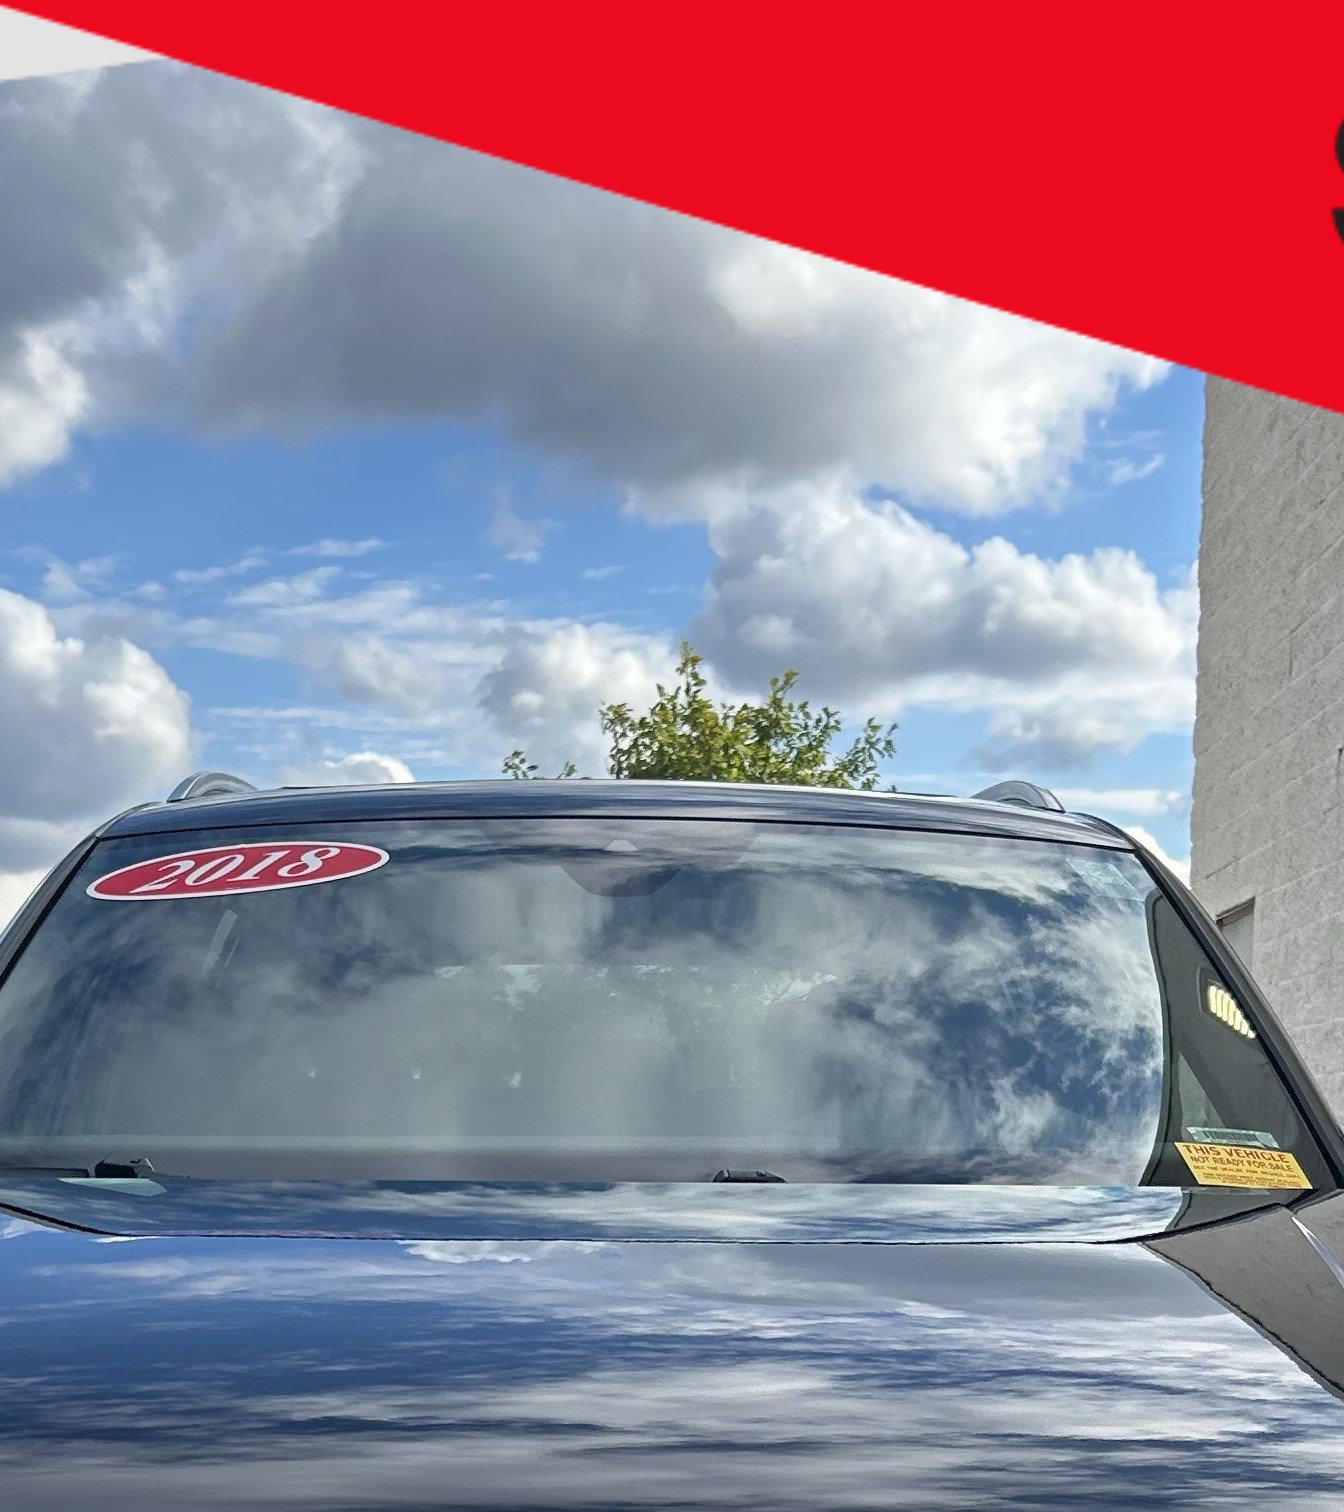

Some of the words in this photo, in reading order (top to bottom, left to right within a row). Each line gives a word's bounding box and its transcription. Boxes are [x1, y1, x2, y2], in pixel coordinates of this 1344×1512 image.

[129, 847, 340, 894] 2018
[1182, 1144, 1222, 1156] THIS
[1223, 1147, 1290, 1162] VEHICLE
[1213, 1158, 1246, 1168] READY
